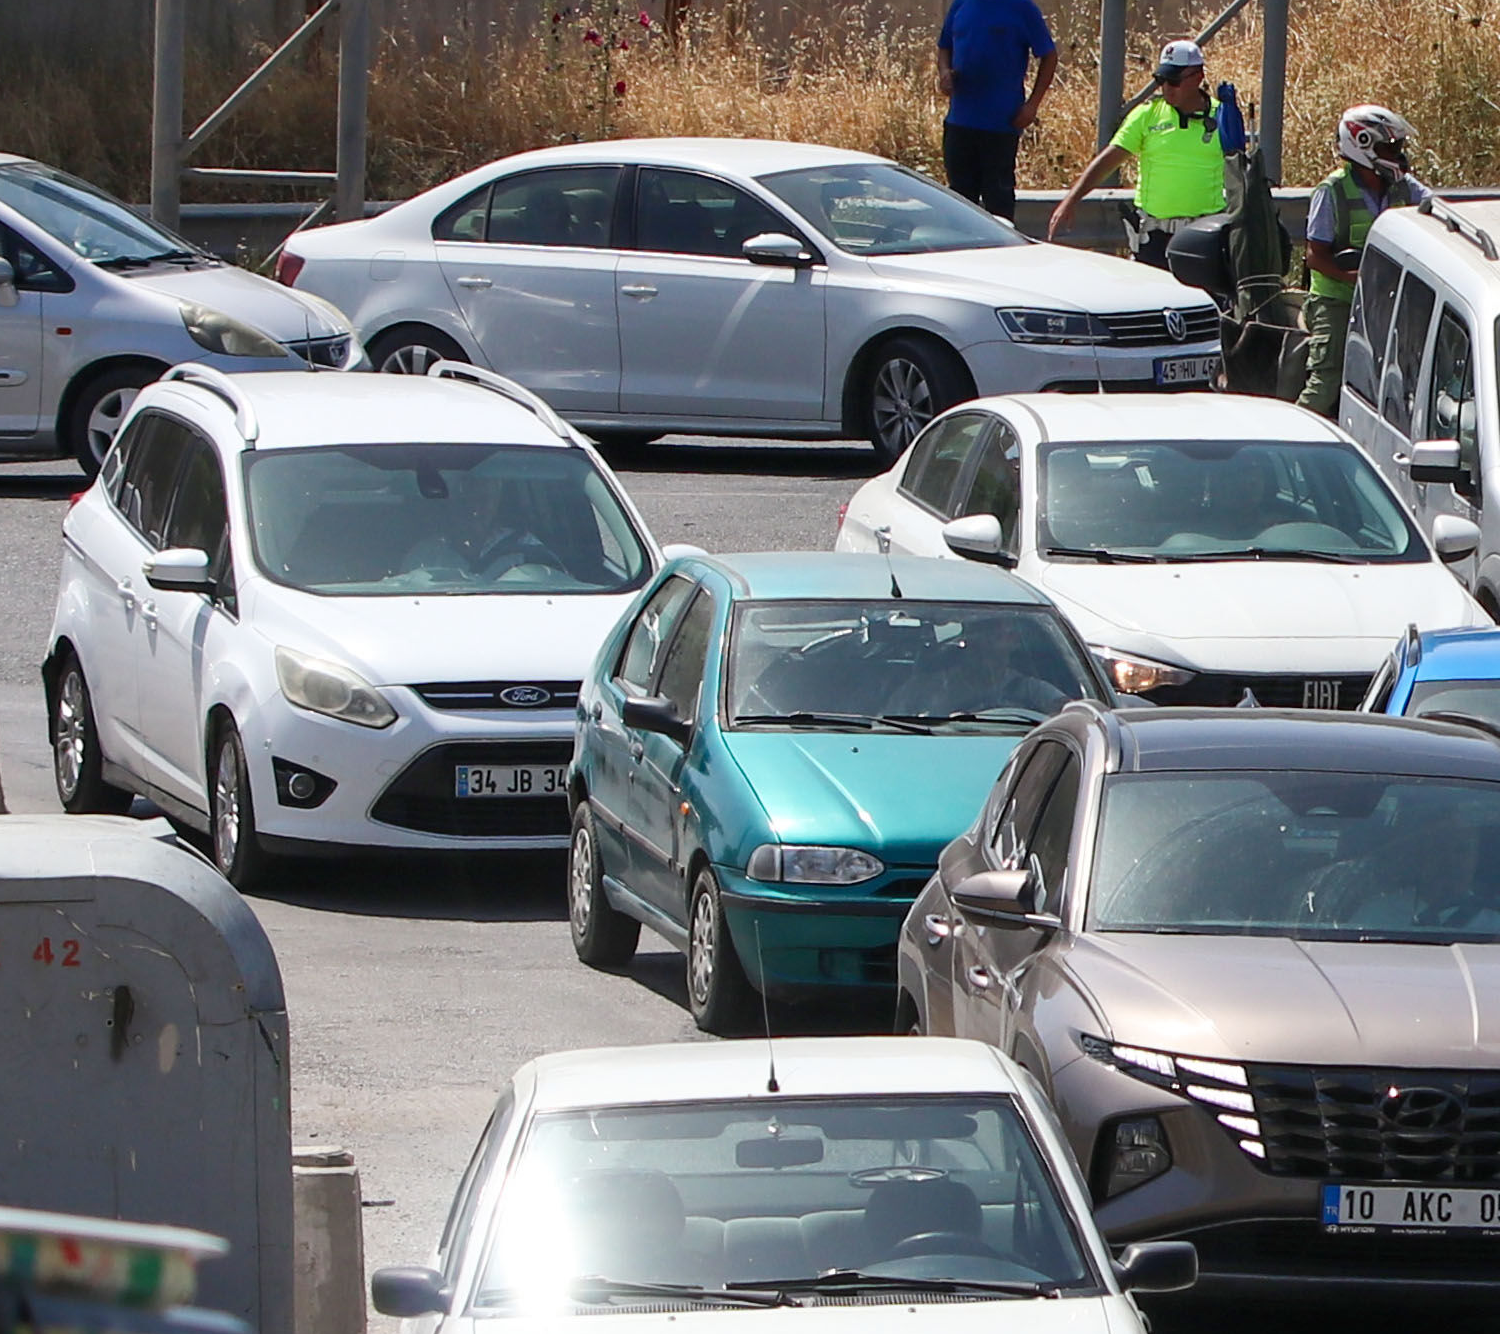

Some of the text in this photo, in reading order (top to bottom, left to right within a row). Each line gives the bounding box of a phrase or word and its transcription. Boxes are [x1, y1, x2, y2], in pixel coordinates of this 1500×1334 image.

[1162, 363, 1177, 380] 45
[1183, 361, 1196, 379] HU
[511, 688, 539, 702] Ford
[1302, 680, 1342, 709] FIAT
[470, 769, 497, 794] 34
[507, 769, 533, 793] JB
[32, 937, 81, 967] 42
[1344, 1189, 1374, 1220] 10
[1402, 1191, 1453, 1223] AKC
